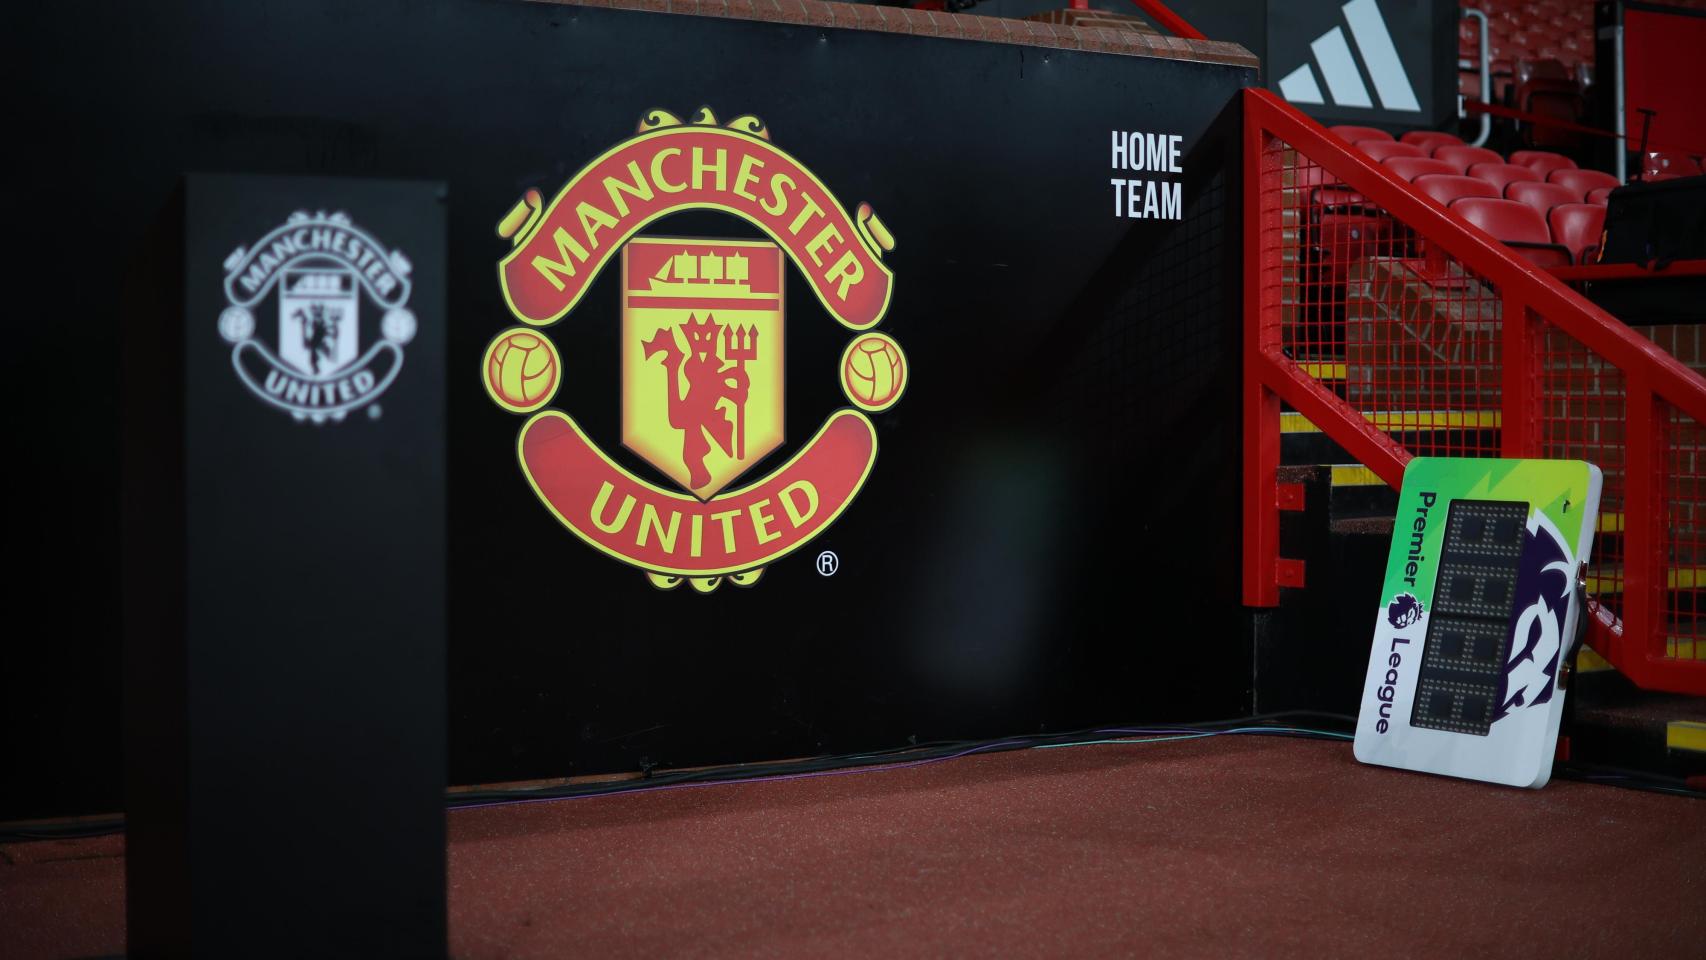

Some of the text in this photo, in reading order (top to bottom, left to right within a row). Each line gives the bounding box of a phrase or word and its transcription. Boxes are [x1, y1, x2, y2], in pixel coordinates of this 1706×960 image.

[1112, 130, 1183, 173] HOME
[531, 146, 865, 302] MANCHESTER
[1111, 178, 1182, 220] TEAM
[240, 228, 397, 297] MANCHESTER
[265, 369, 375, 405] UNITED
[590, 479, 820, 557] UNITED
[1376, 491, 1437, 735] Premier League
